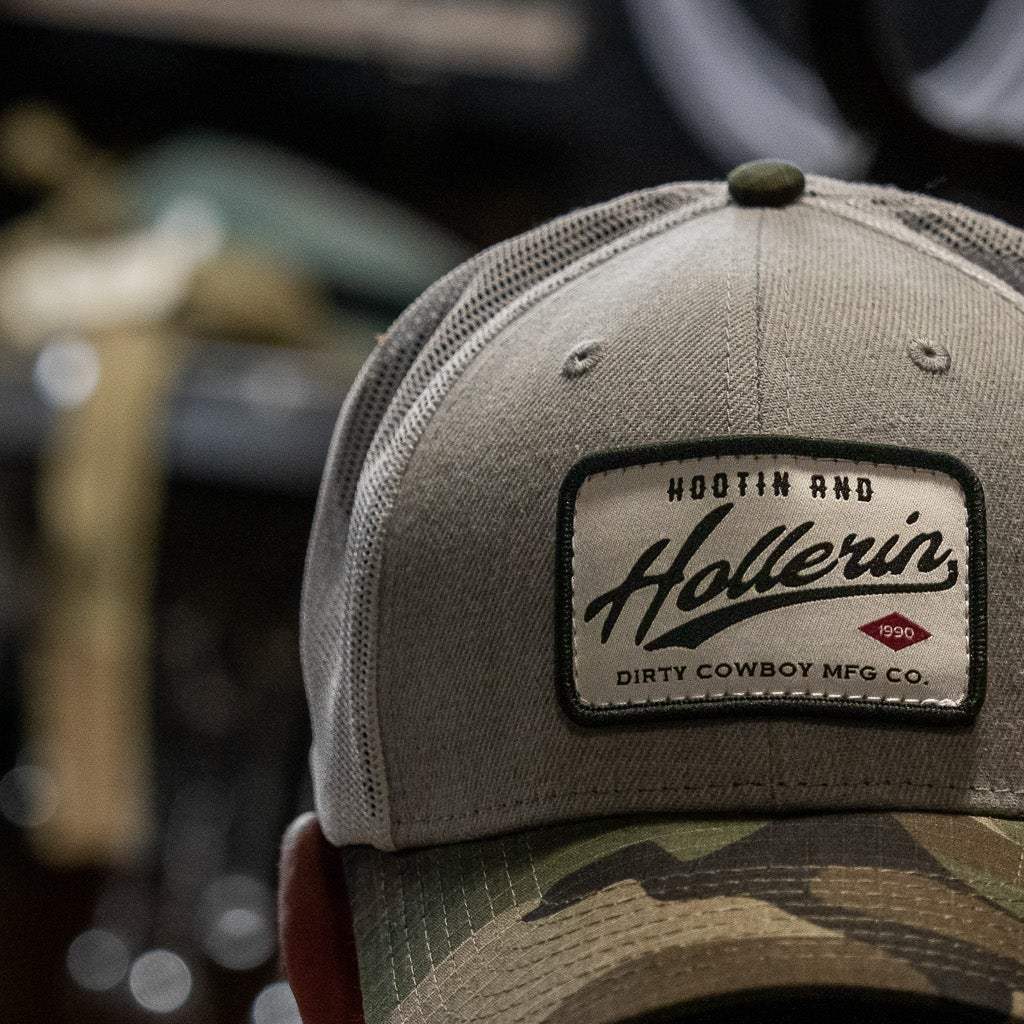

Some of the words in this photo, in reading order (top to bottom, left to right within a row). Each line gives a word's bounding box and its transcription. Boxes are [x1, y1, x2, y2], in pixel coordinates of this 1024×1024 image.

[666, 471, 792, 502] HOOTIN
[809, 474, 874, 503] AND
[584, 502, 954, 647] Hollerin
[878, 624, 915, 640] 1990
[616, 665, 688, 687] DIRTY
[696, 661, 815, 681] COWBOY
[822, 664, 878, 682] MFG
[886, 667, 930, 687] CO.
